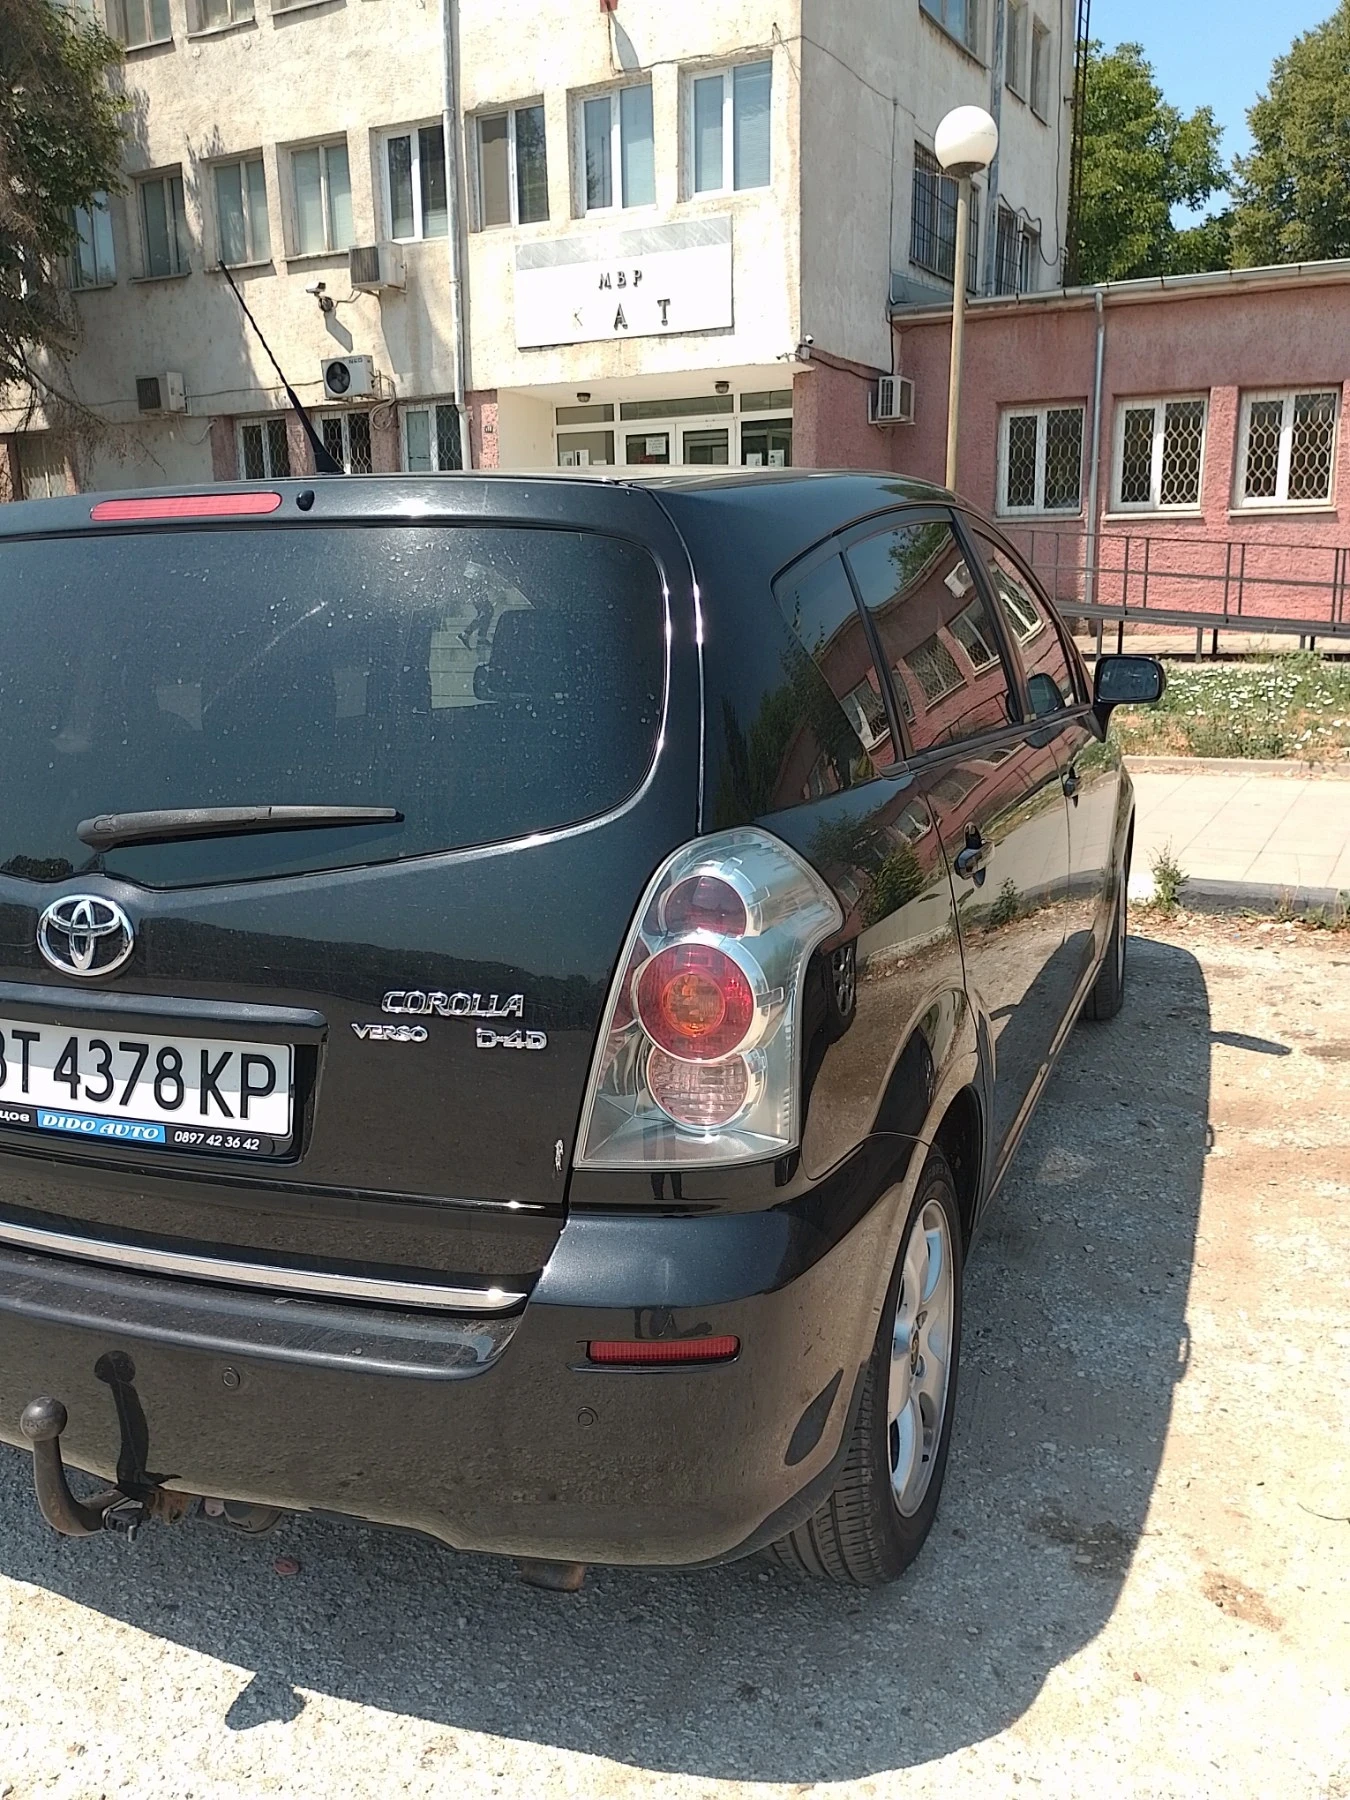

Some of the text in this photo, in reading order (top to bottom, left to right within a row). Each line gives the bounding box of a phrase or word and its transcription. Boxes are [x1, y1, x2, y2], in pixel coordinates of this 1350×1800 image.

[598, 269, 643, 290] МВР
[381, 990, 525, 1018] COROLLA
[351, 1023, 429, 1043] VERSO
[475, 1027, 548, 1050] D-4D
[0, 1029, 277, 1119] T 4378 KP
[42, 1114, 159, 1139] DIDO AUTO
[174, 1130, 260, 1151] 0897 42 36 42
